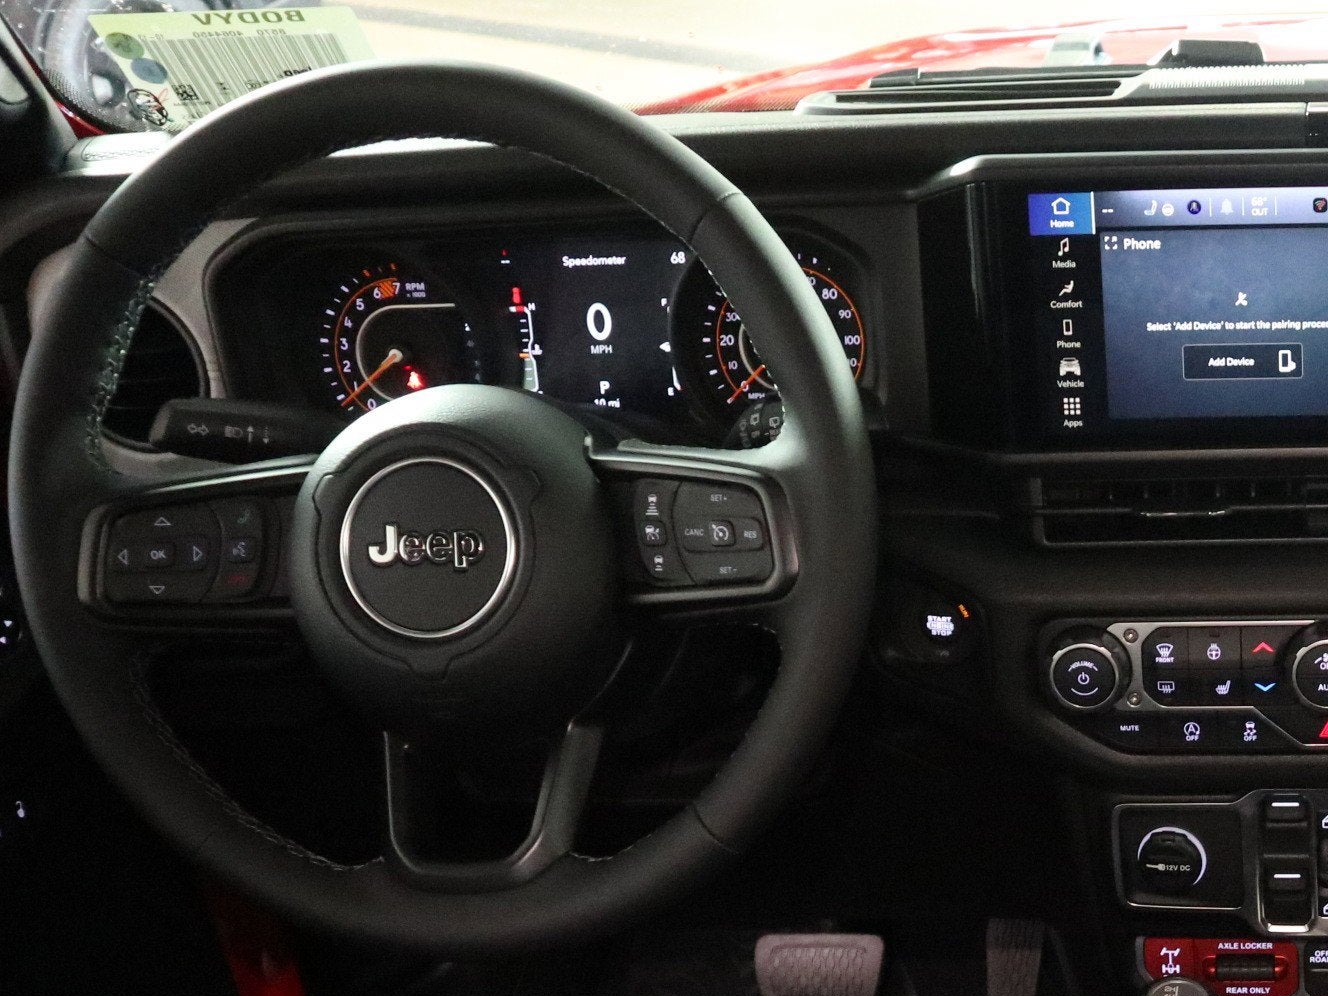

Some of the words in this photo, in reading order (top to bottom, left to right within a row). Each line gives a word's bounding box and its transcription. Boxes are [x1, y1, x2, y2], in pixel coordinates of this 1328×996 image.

[1251, 208, 1268, 216] OUT
[1050, 220, 1075, 228] Home
[1123, 238, 1161, 250] Phone
[562, 255, 626, 268] Speedometer
[671, 251, 686, 264] 68
[1052, 260, 1076, 268] Media
[392, 282, 401, 294] 7
[405, 282, 425, 291] RPM
[373, 287, 381, 298] 6
[822, 288, 838, 300] 80
[356, 298, 365, 311] 5
[1050, 300, 1083, 308] Comfort
[726, 312, 738, 322] 30
[838, 310, 852, 319] 90
[344, 317, 352, 328] 4
[586, 302, 612, 341] 0
[1146, 322, 1171, 331] Select
[1225, 322, 1234, 330] to
[1236, 321, 1255, 330] start
[1256, 321, 1271, 329] the
[1272, 320, 1300, 330] pairing
[340, 338, 349, 350] 3
[720, 335, 734, 346] 20
[844, 335, 860, 345] 100
[1056, 340, 1082, 348] Phone
[591, 345, 612, 354] MPH
[343, 360, 351, 373] 2
[728, 361, 738, 370] 10
[1208, 358, 1225, 367] Add
[1226, 357, 1255, 366] Device
[600, 381, 610, 394] P
[1057, 380, 1085, 388] Vehicle
[368, 399, 377, 410] 0
[1063, 419, 1083, 428] Apps
[744, 531, 757, 539] RES
[367, 524, 485, 569] Jeep
[150, 550, 166, 560] OK
[1240, 942, 1273, 950] LOCKER
